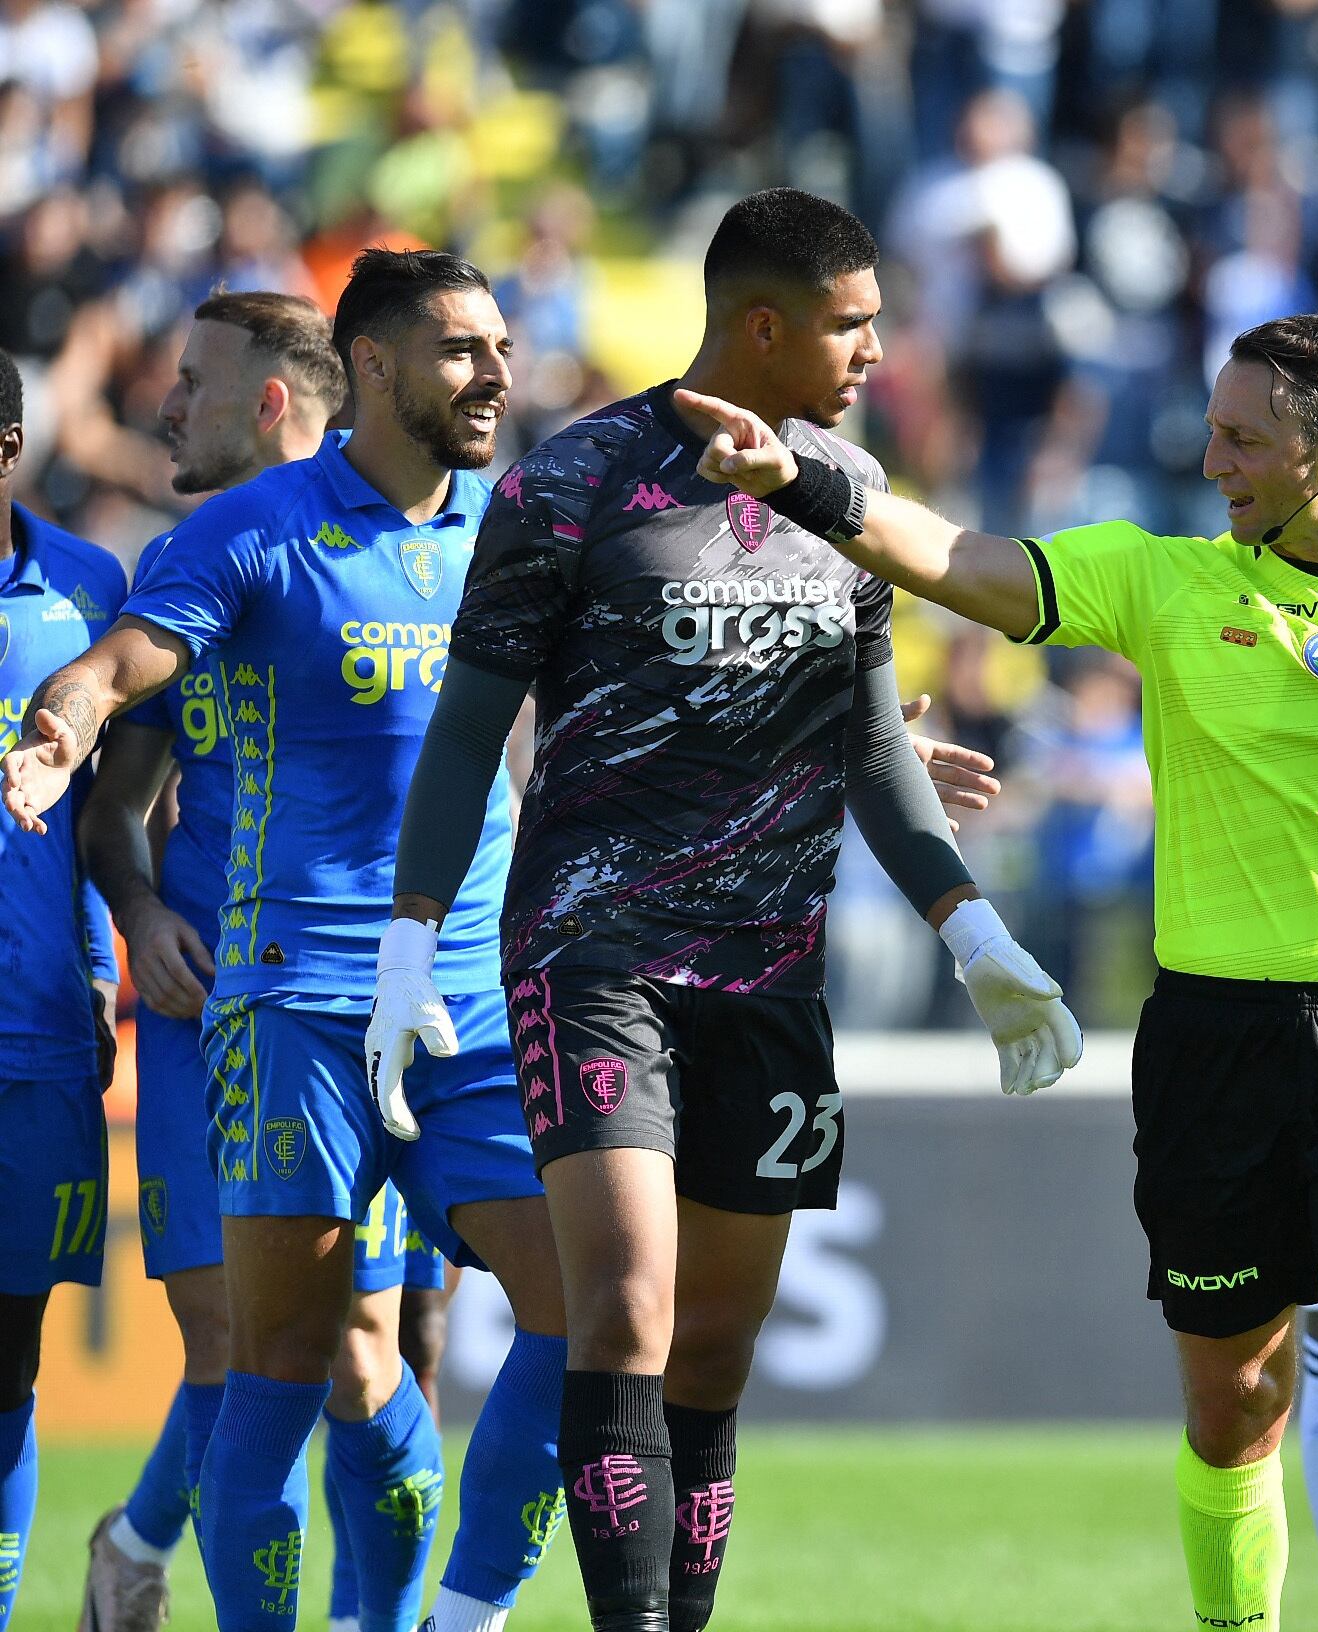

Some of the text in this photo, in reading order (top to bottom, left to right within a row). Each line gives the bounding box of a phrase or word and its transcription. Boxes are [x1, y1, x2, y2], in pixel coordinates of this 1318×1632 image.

[661, 573, 840, 606] computer
[340, 621, 451, 649] comp
[661, 603, 844, 666] gross
[340, 646, 449, 704] gro
[583, 1061, 609, 1072] EMPOLI
[266, 1121, 291, 1130] EMPOLI
[755, 1091, 844, 1179] 23
[50, 1179, 97, 1261] 11
[1167, 1266, 1259, 1291] GIVOVA
[592, 1520, 640, 1539] 1920
[684, 1557, 719, 1575] 1920
[261, 1599, 294, 1616] 1920
